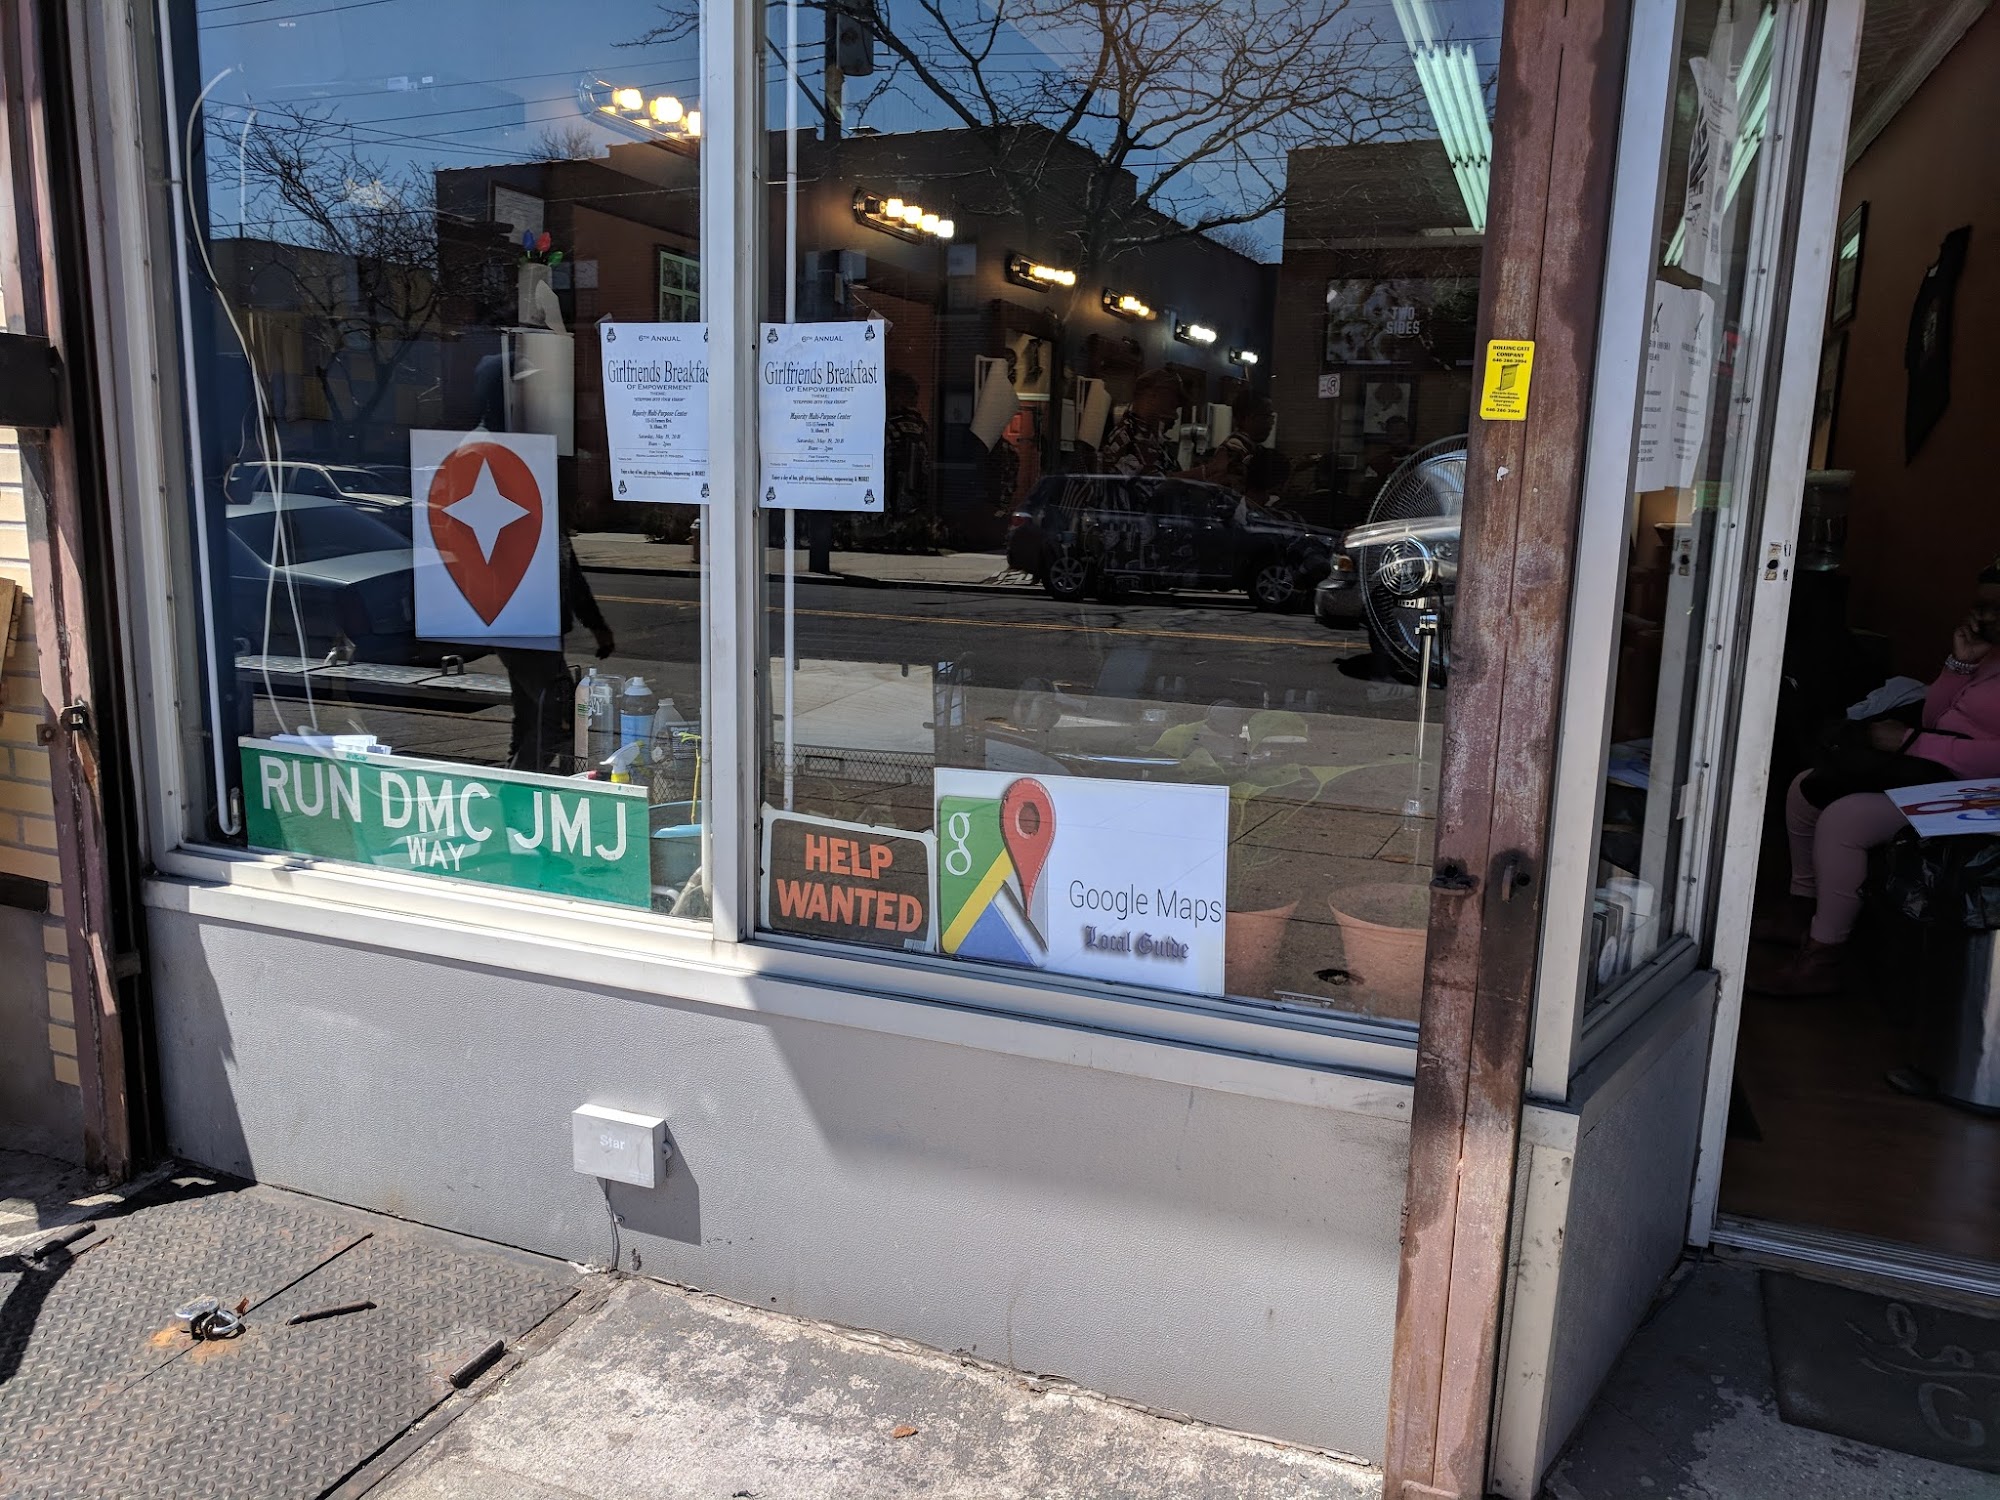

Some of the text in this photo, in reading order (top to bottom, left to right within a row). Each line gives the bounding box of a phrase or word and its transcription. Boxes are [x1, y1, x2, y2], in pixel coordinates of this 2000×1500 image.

[1386, 320, 1420, 334] SIDES
[1392, 306, 1416, 320] TWO
[608, 360, 708, 383] Girlfriends Breakfas
[765, 360, 878, 384] Girlfriends Breakfast
[259, 755, 626, 862] RUN DMC JMJ
[406, 836, 466, 872] WAY
[805, 834, 893, 880] HELP
[776, 878, 922, 933] WANTED
[1070, 880, 1222, 928] Google Maps
[1084, 924, 1190, 959] Local Guide
[600, 1134, 626, 1150] Star
